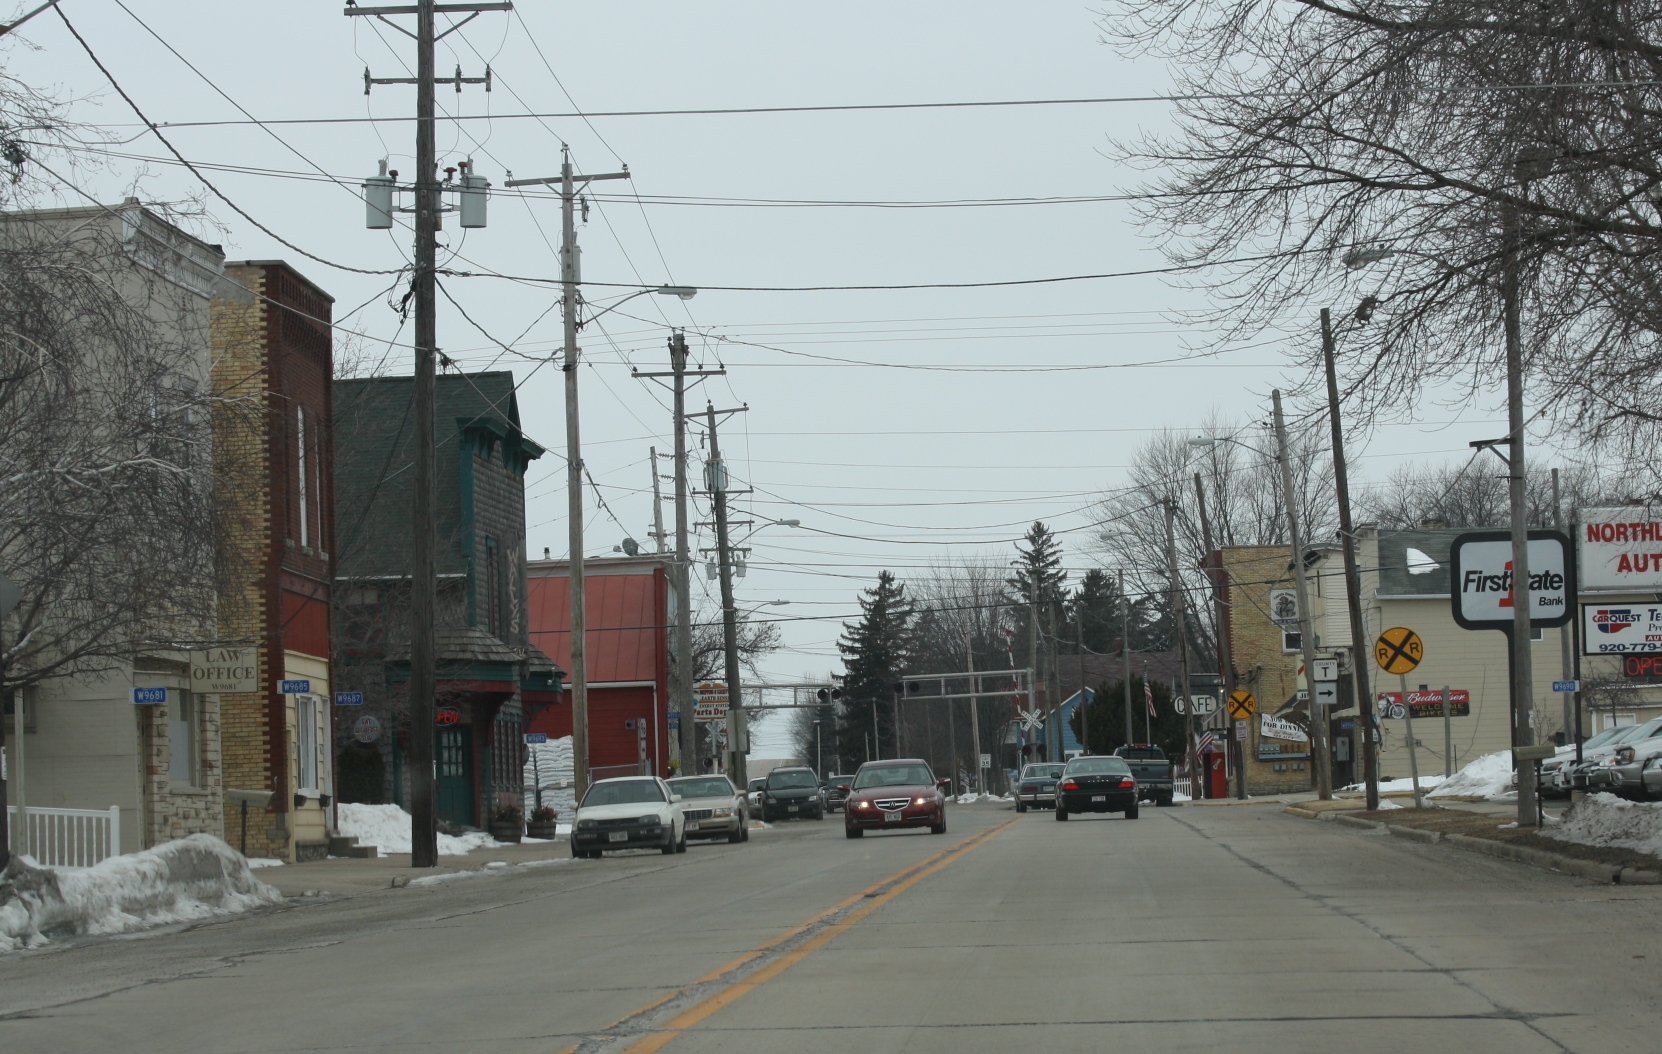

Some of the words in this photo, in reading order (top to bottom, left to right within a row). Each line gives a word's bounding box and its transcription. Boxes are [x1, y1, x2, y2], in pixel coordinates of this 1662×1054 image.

[1587, 522, 1662, 542] NORTHL
[1617, 553, 1662, 572] AUT
[1463, 570, 1563, 593] Firstate
[1539, 596, 1564, 606] Bank
[1592, 614, 1641, 623] CARQUEST
[1648, 609, 1662, 621] TE
[1379, 648, 1389, 660] R
[1409, 642, 1420, 654] R
[1599, 643, 1662, 652] 920-779-
[206, 650, 240, 662] LAW
[1627, 656, 1662, 676] OPE
[193, 667, 255, 680] OFFICE
[1321, 667, 1329, 677] T
[284, 683, 308, 691] W9685
[1554, 682, 1574, 690] W9690
[137, 690, 163, 700] W9681
[337, 694, 360, 702] W9687
[1299, 691, 1309, 699] JI
[1407, 692, 1466, 704] Budwser
[1412, 703, 1464, 711] WELCME
[1263, 721, 1277, 729] FOR
